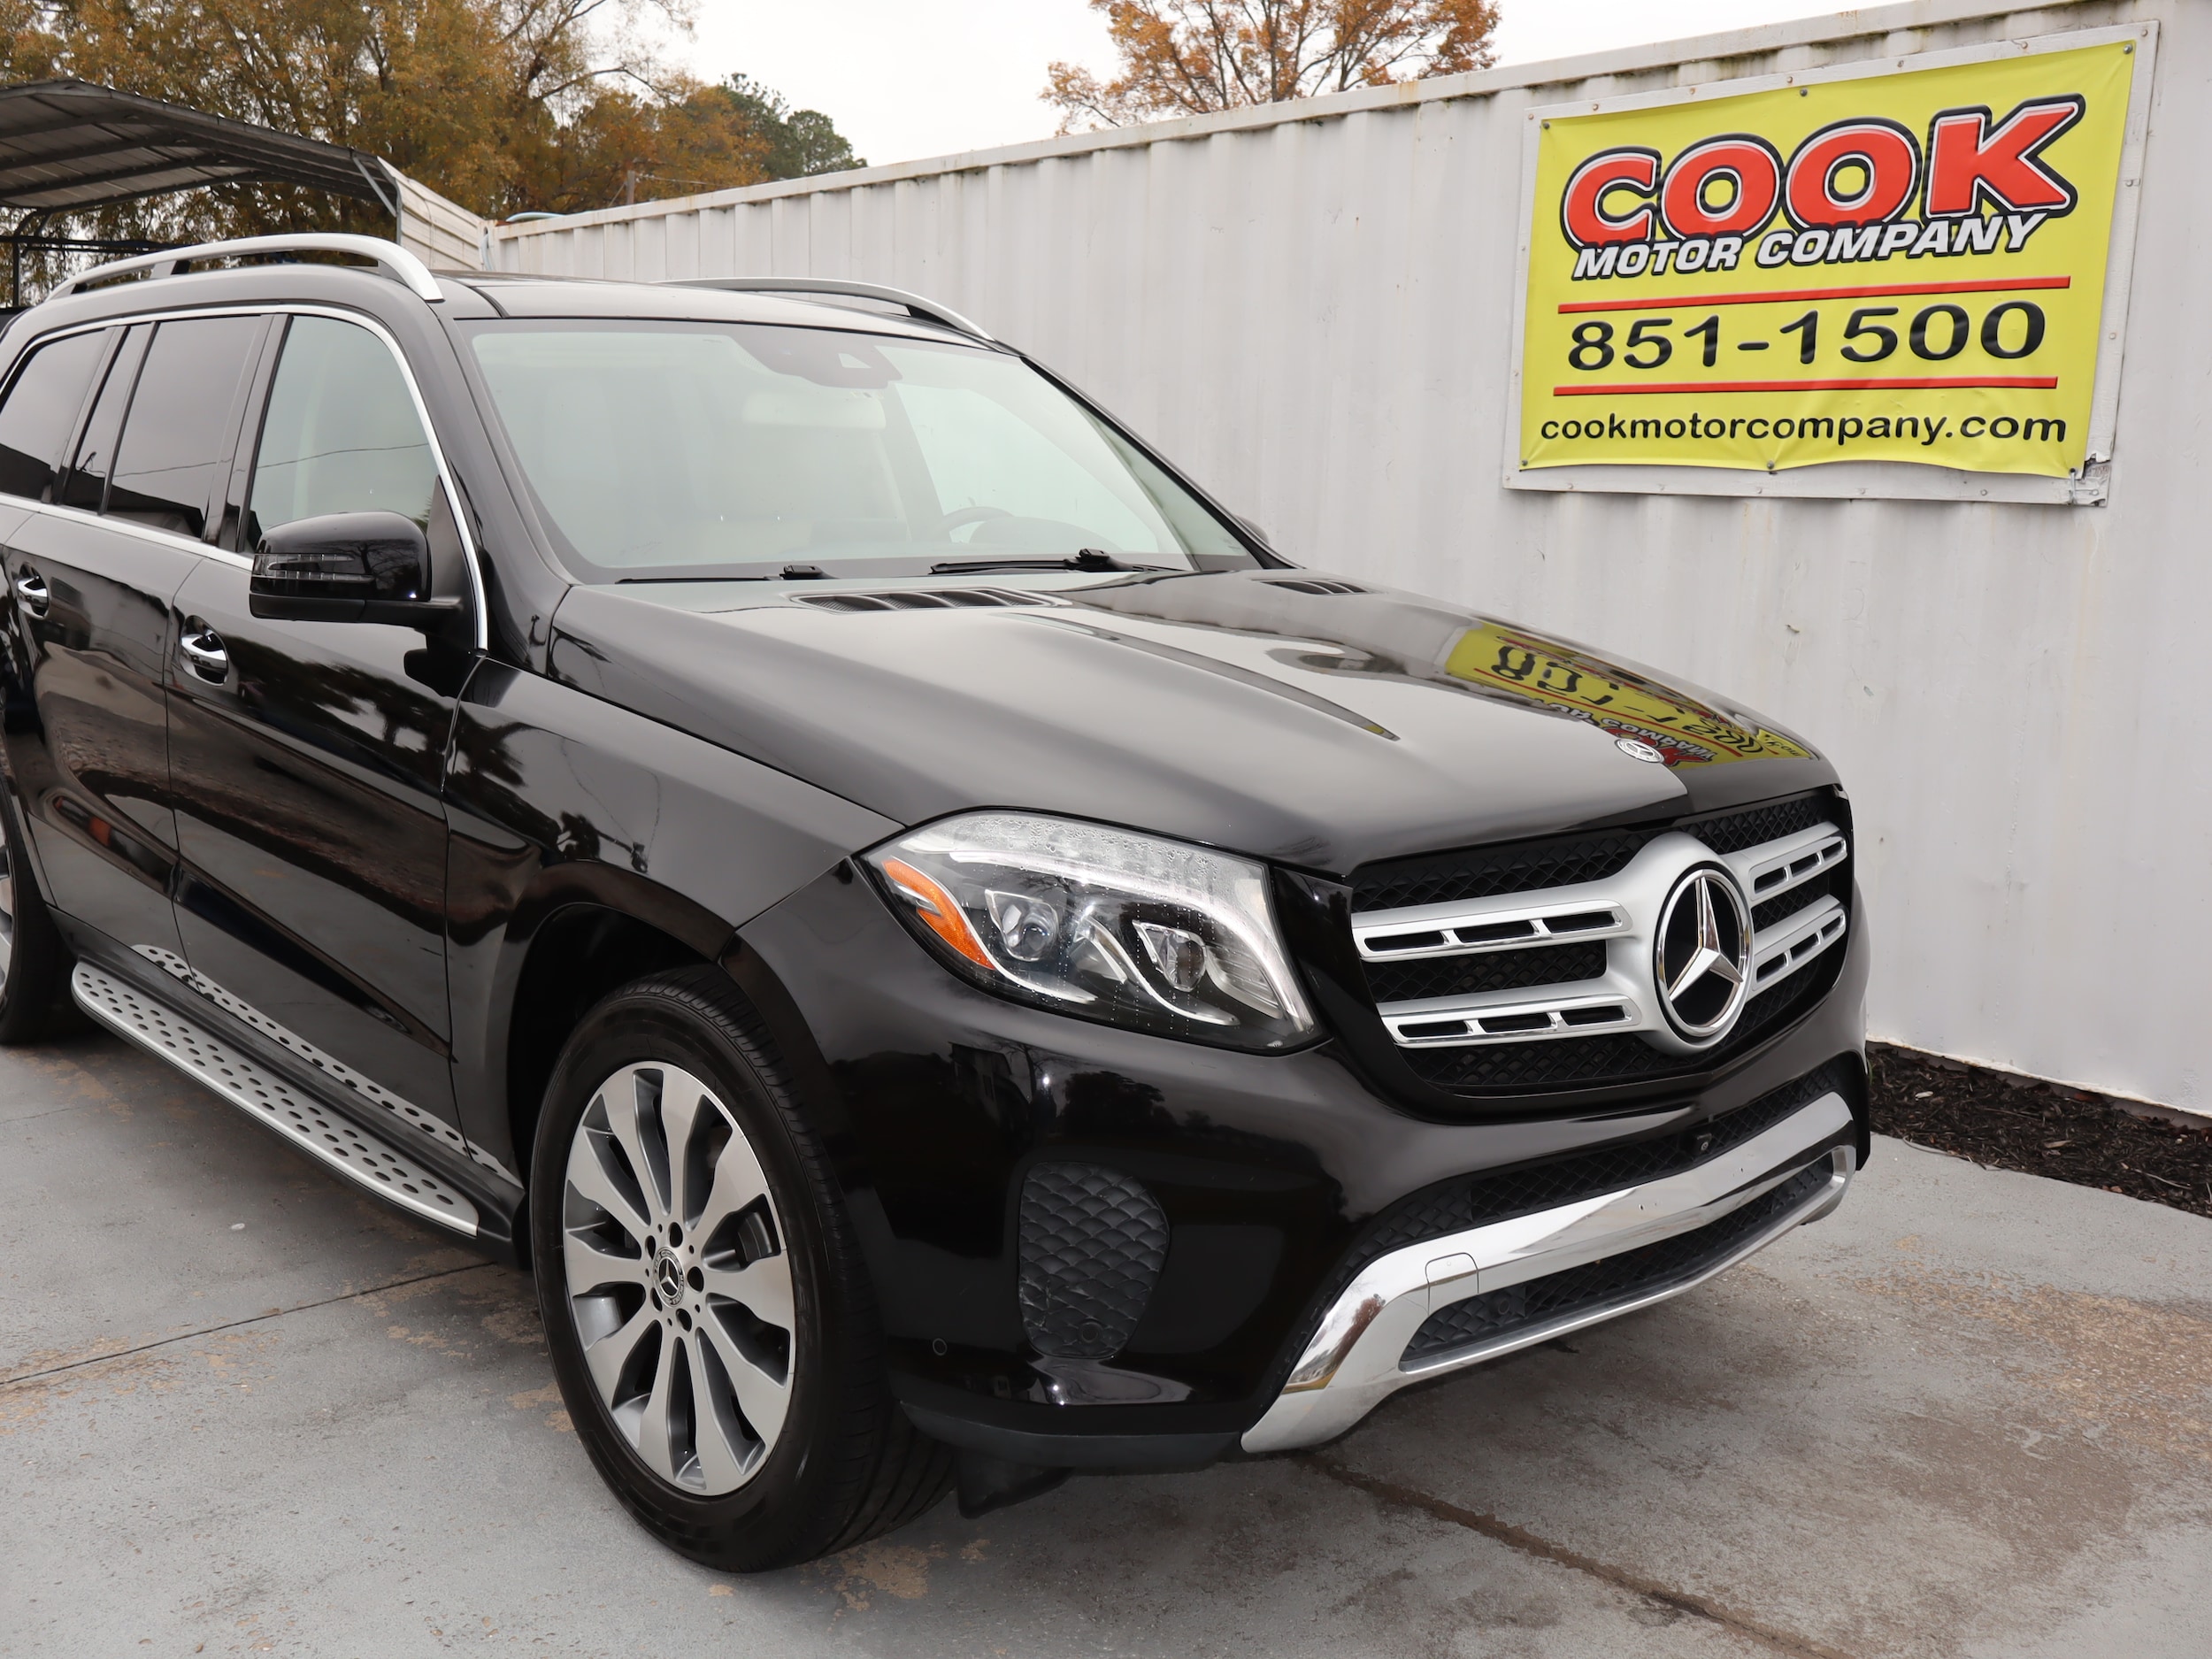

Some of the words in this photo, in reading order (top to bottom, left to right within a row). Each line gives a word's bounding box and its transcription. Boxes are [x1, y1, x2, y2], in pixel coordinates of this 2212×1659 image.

[1561, 94, 2085, 251] COOK
[1571, 235, 1744, 280] MOTOR
[1755, 213, 2047, 268] COMPANY
[1568, 300, 2046, 371] 851-1500
[1540, 411, 2067, 446] cookmotorcompany.com
